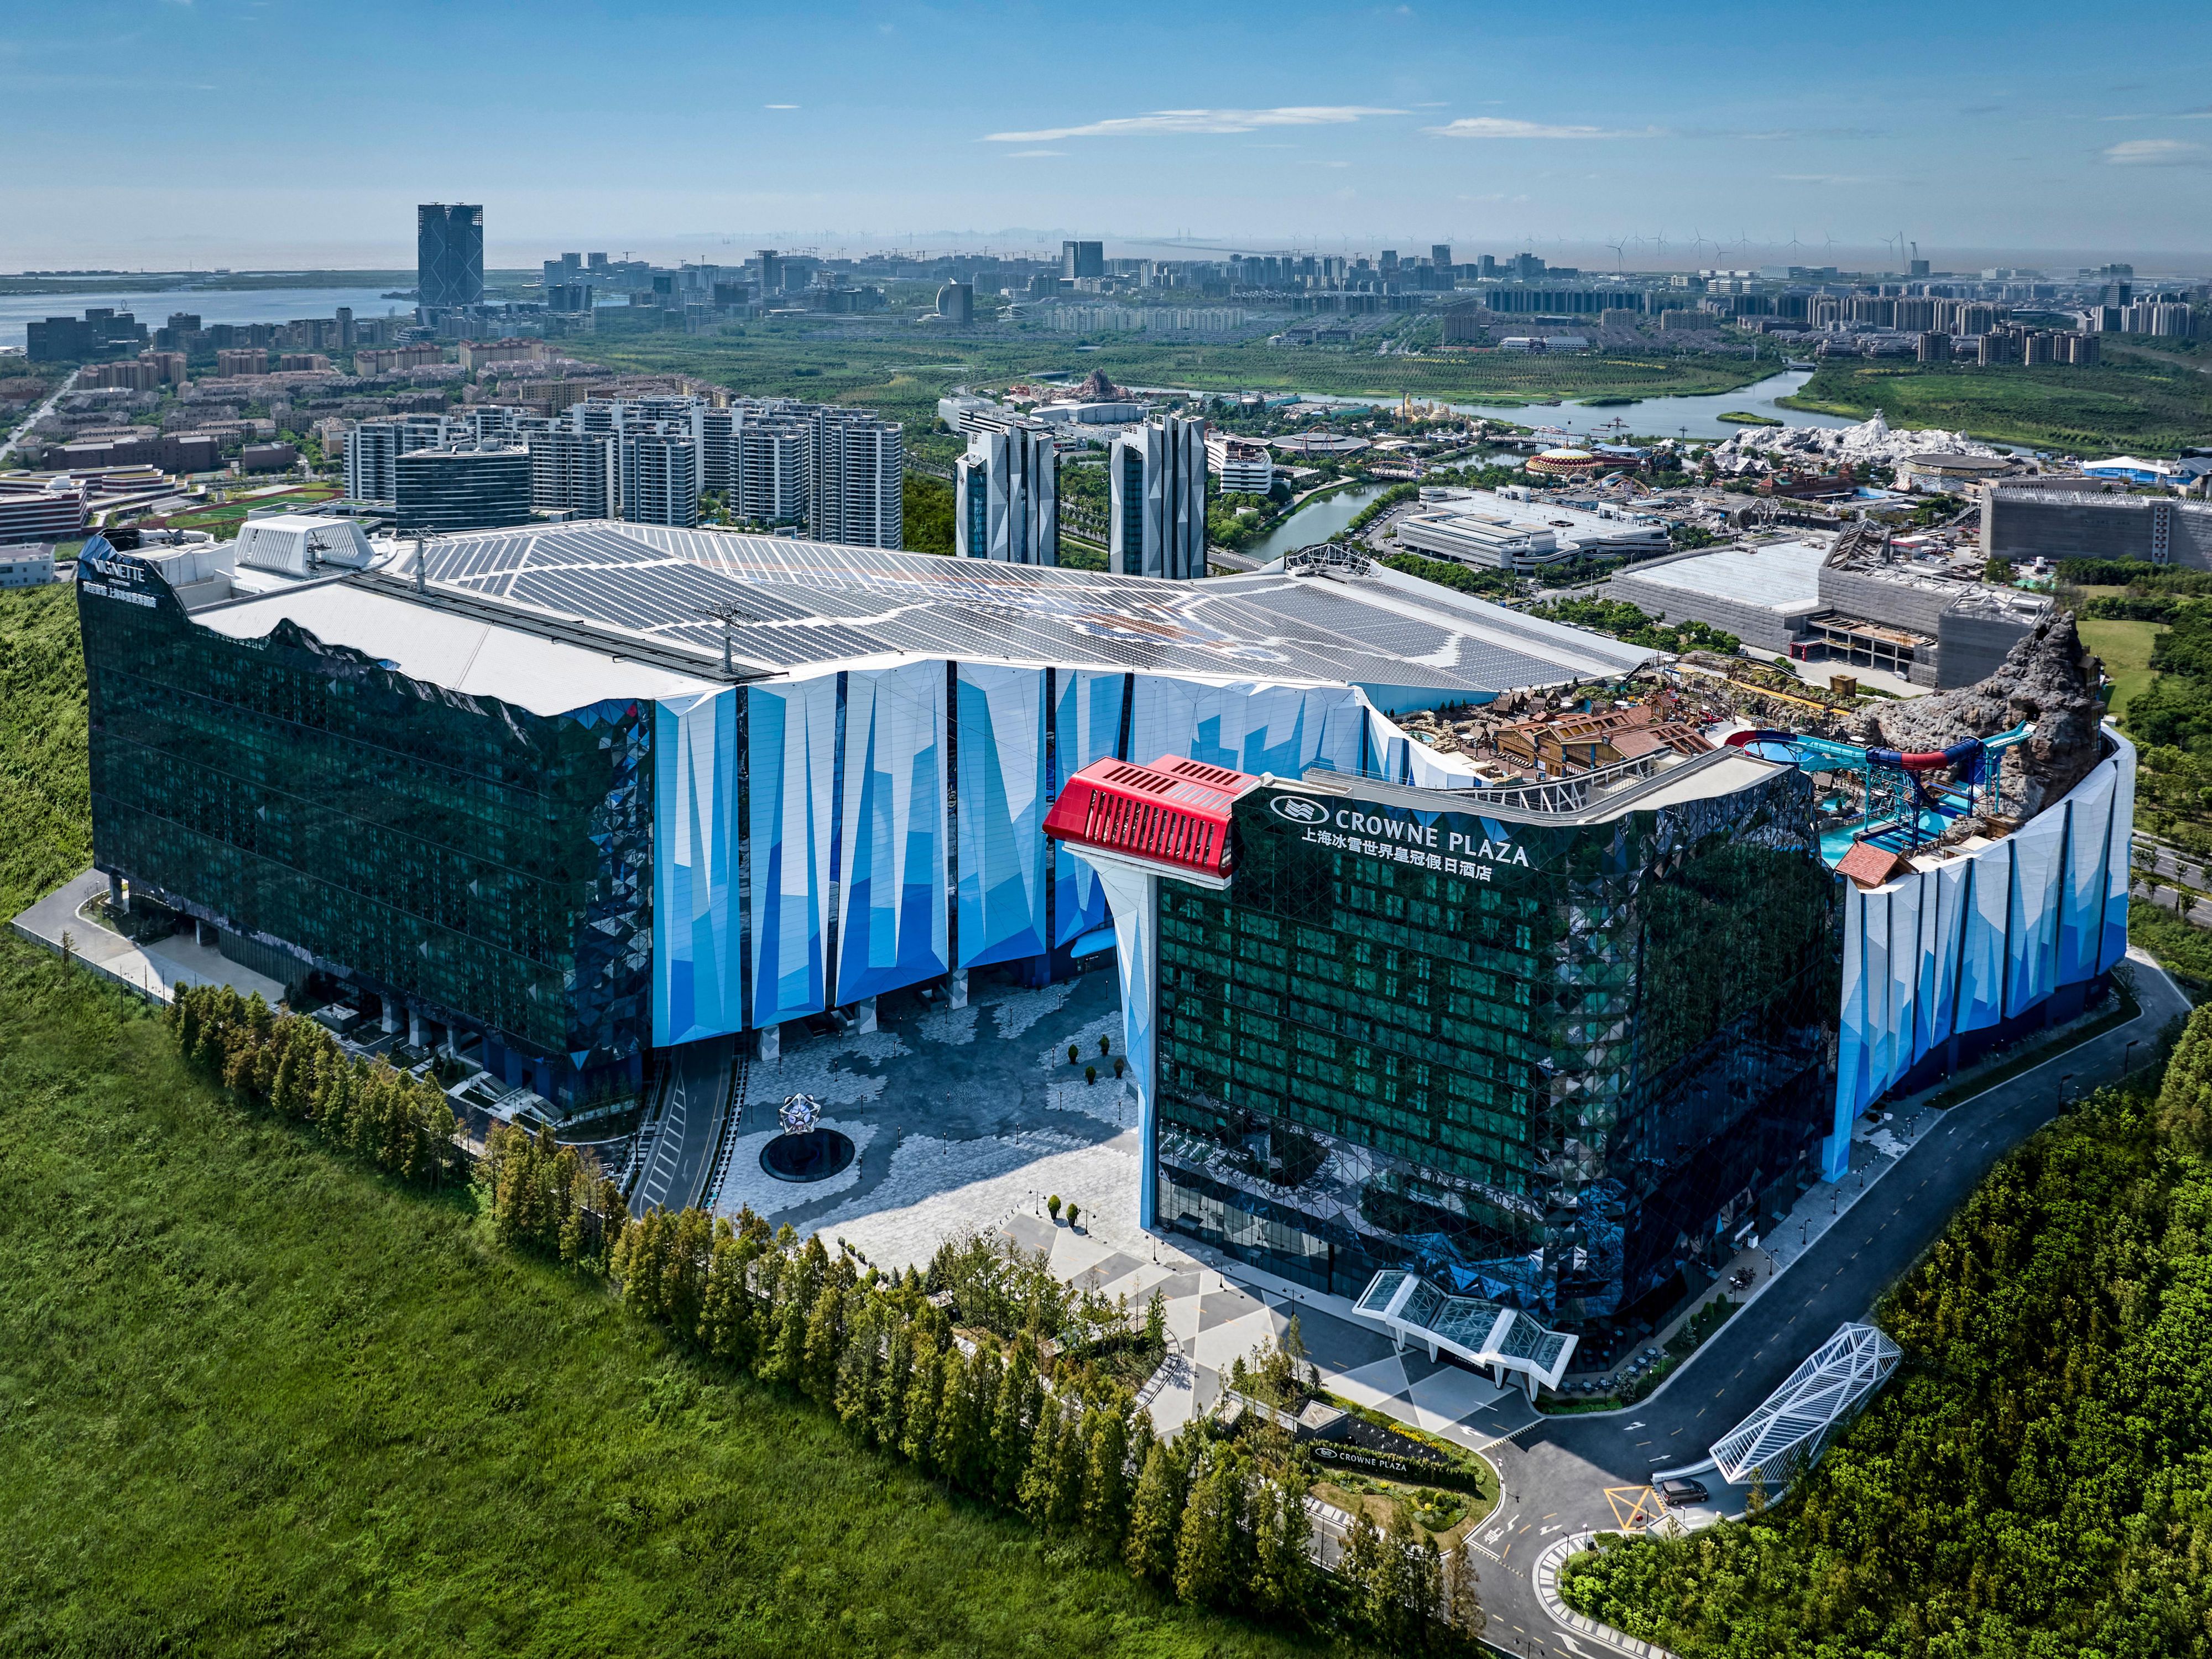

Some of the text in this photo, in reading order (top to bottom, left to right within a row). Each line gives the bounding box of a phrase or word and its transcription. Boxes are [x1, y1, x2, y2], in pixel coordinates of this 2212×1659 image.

[92, 558, 145, 582] VIGNETTE
[1301, 827, 1493, 882] 上海冰雪世界皇冠假日酒店
[1335, 810, 1530, 867] CROWNE PLAZA
[1339, 1452, 1407, 1472] CROWNE PLAZA
